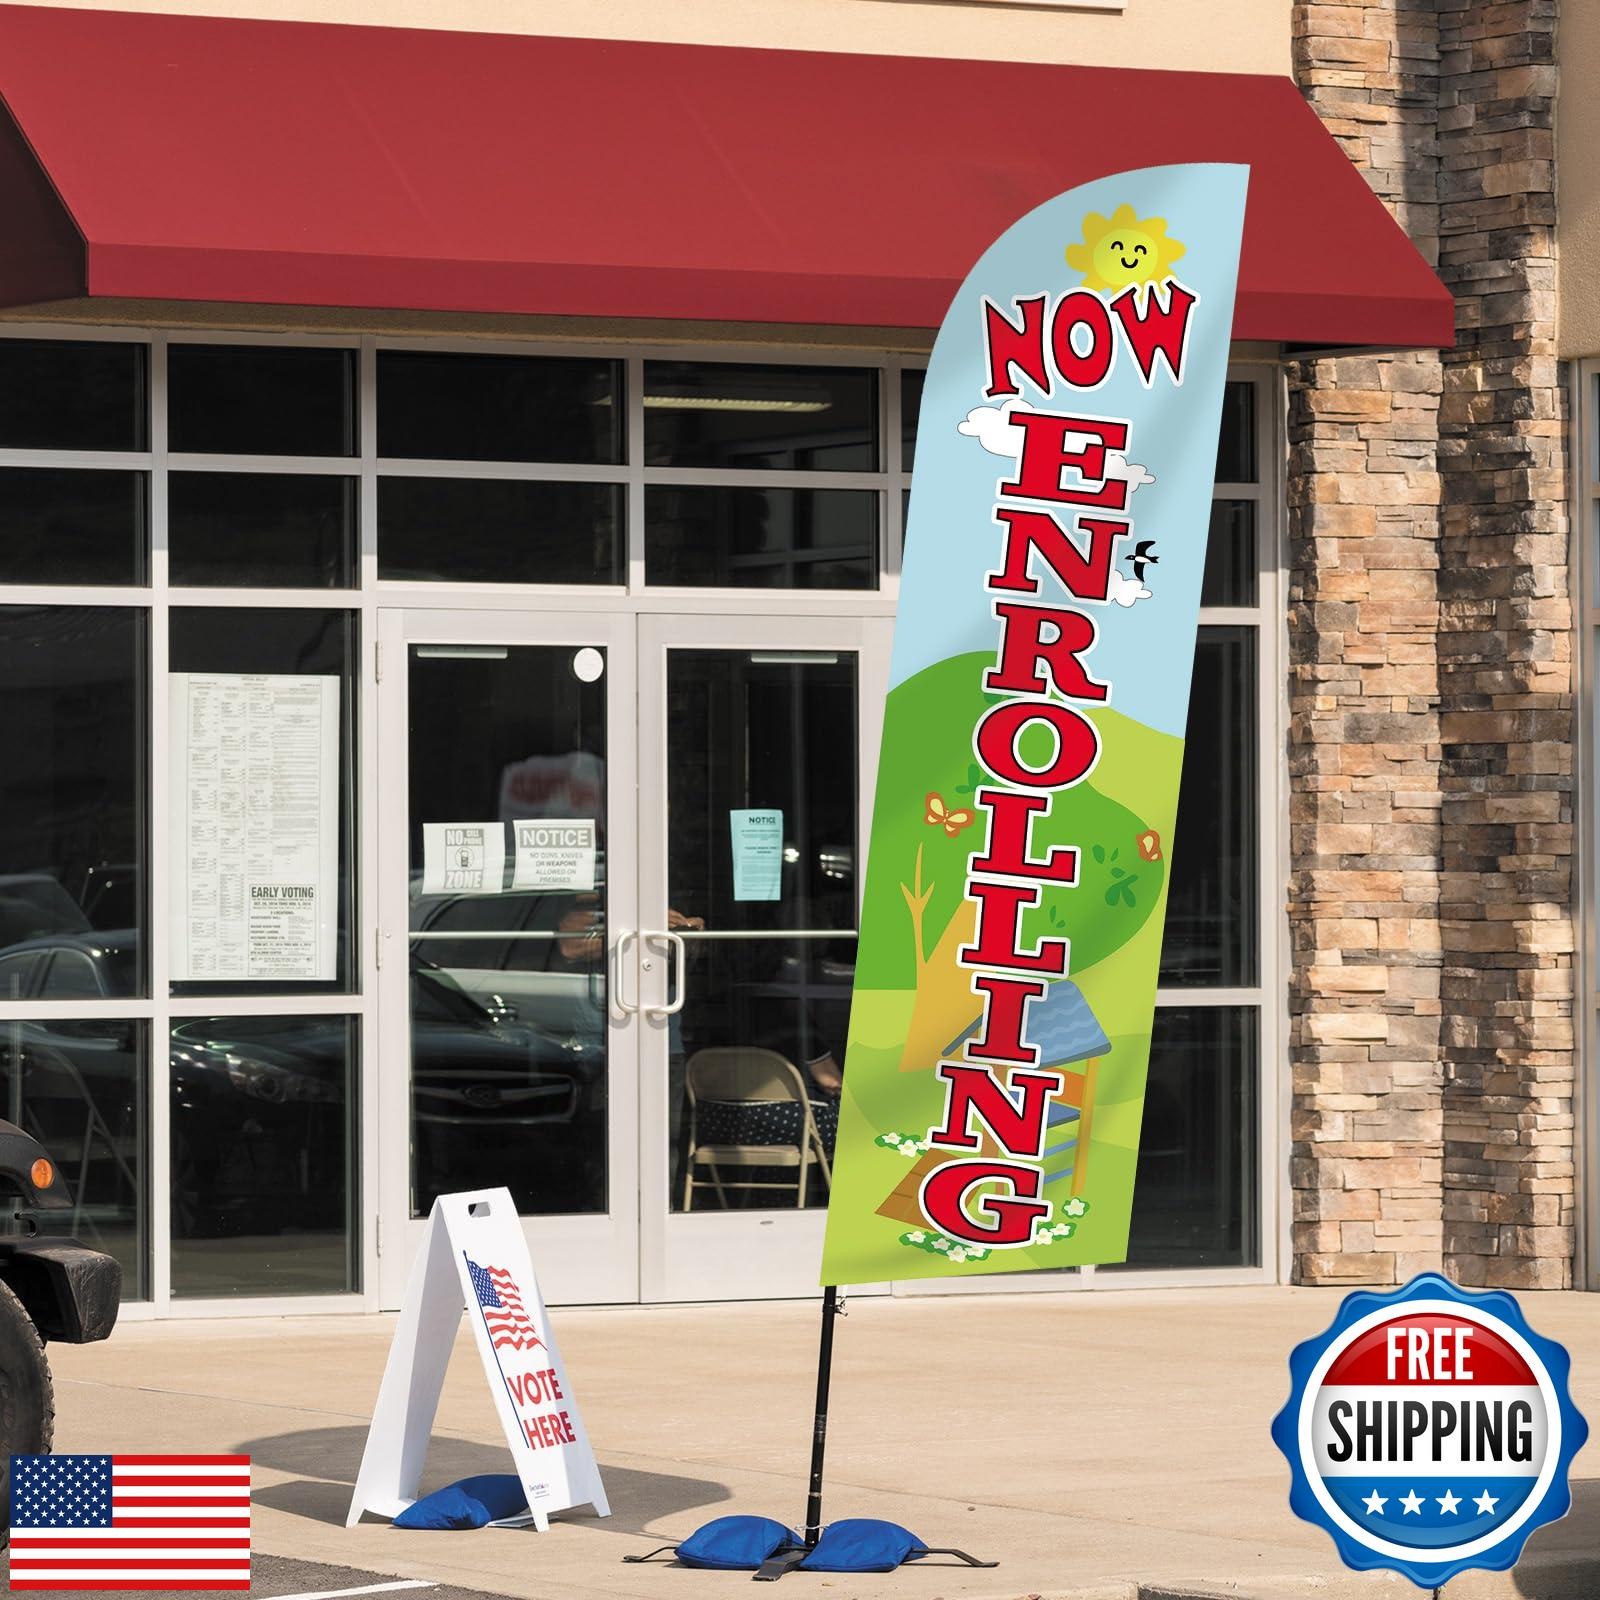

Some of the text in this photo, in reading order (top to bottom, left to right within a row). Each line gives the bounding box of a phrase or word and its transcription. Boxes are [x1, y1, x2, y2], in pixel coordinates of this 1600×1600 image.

[984, 280, 1197, 397] NOW
[446, 829, 464, 845] NO
[522, 829, 589, 847] NOTICE
[922, 411, 1130, 1245] ENROLLING
[251, 886, 314, 898] EARLY VOTING
[446, 870, 482, 888] ZONE
[507, 1368, 563, 1407] VOTE
[524, 1411, 576, 1450] HERE
